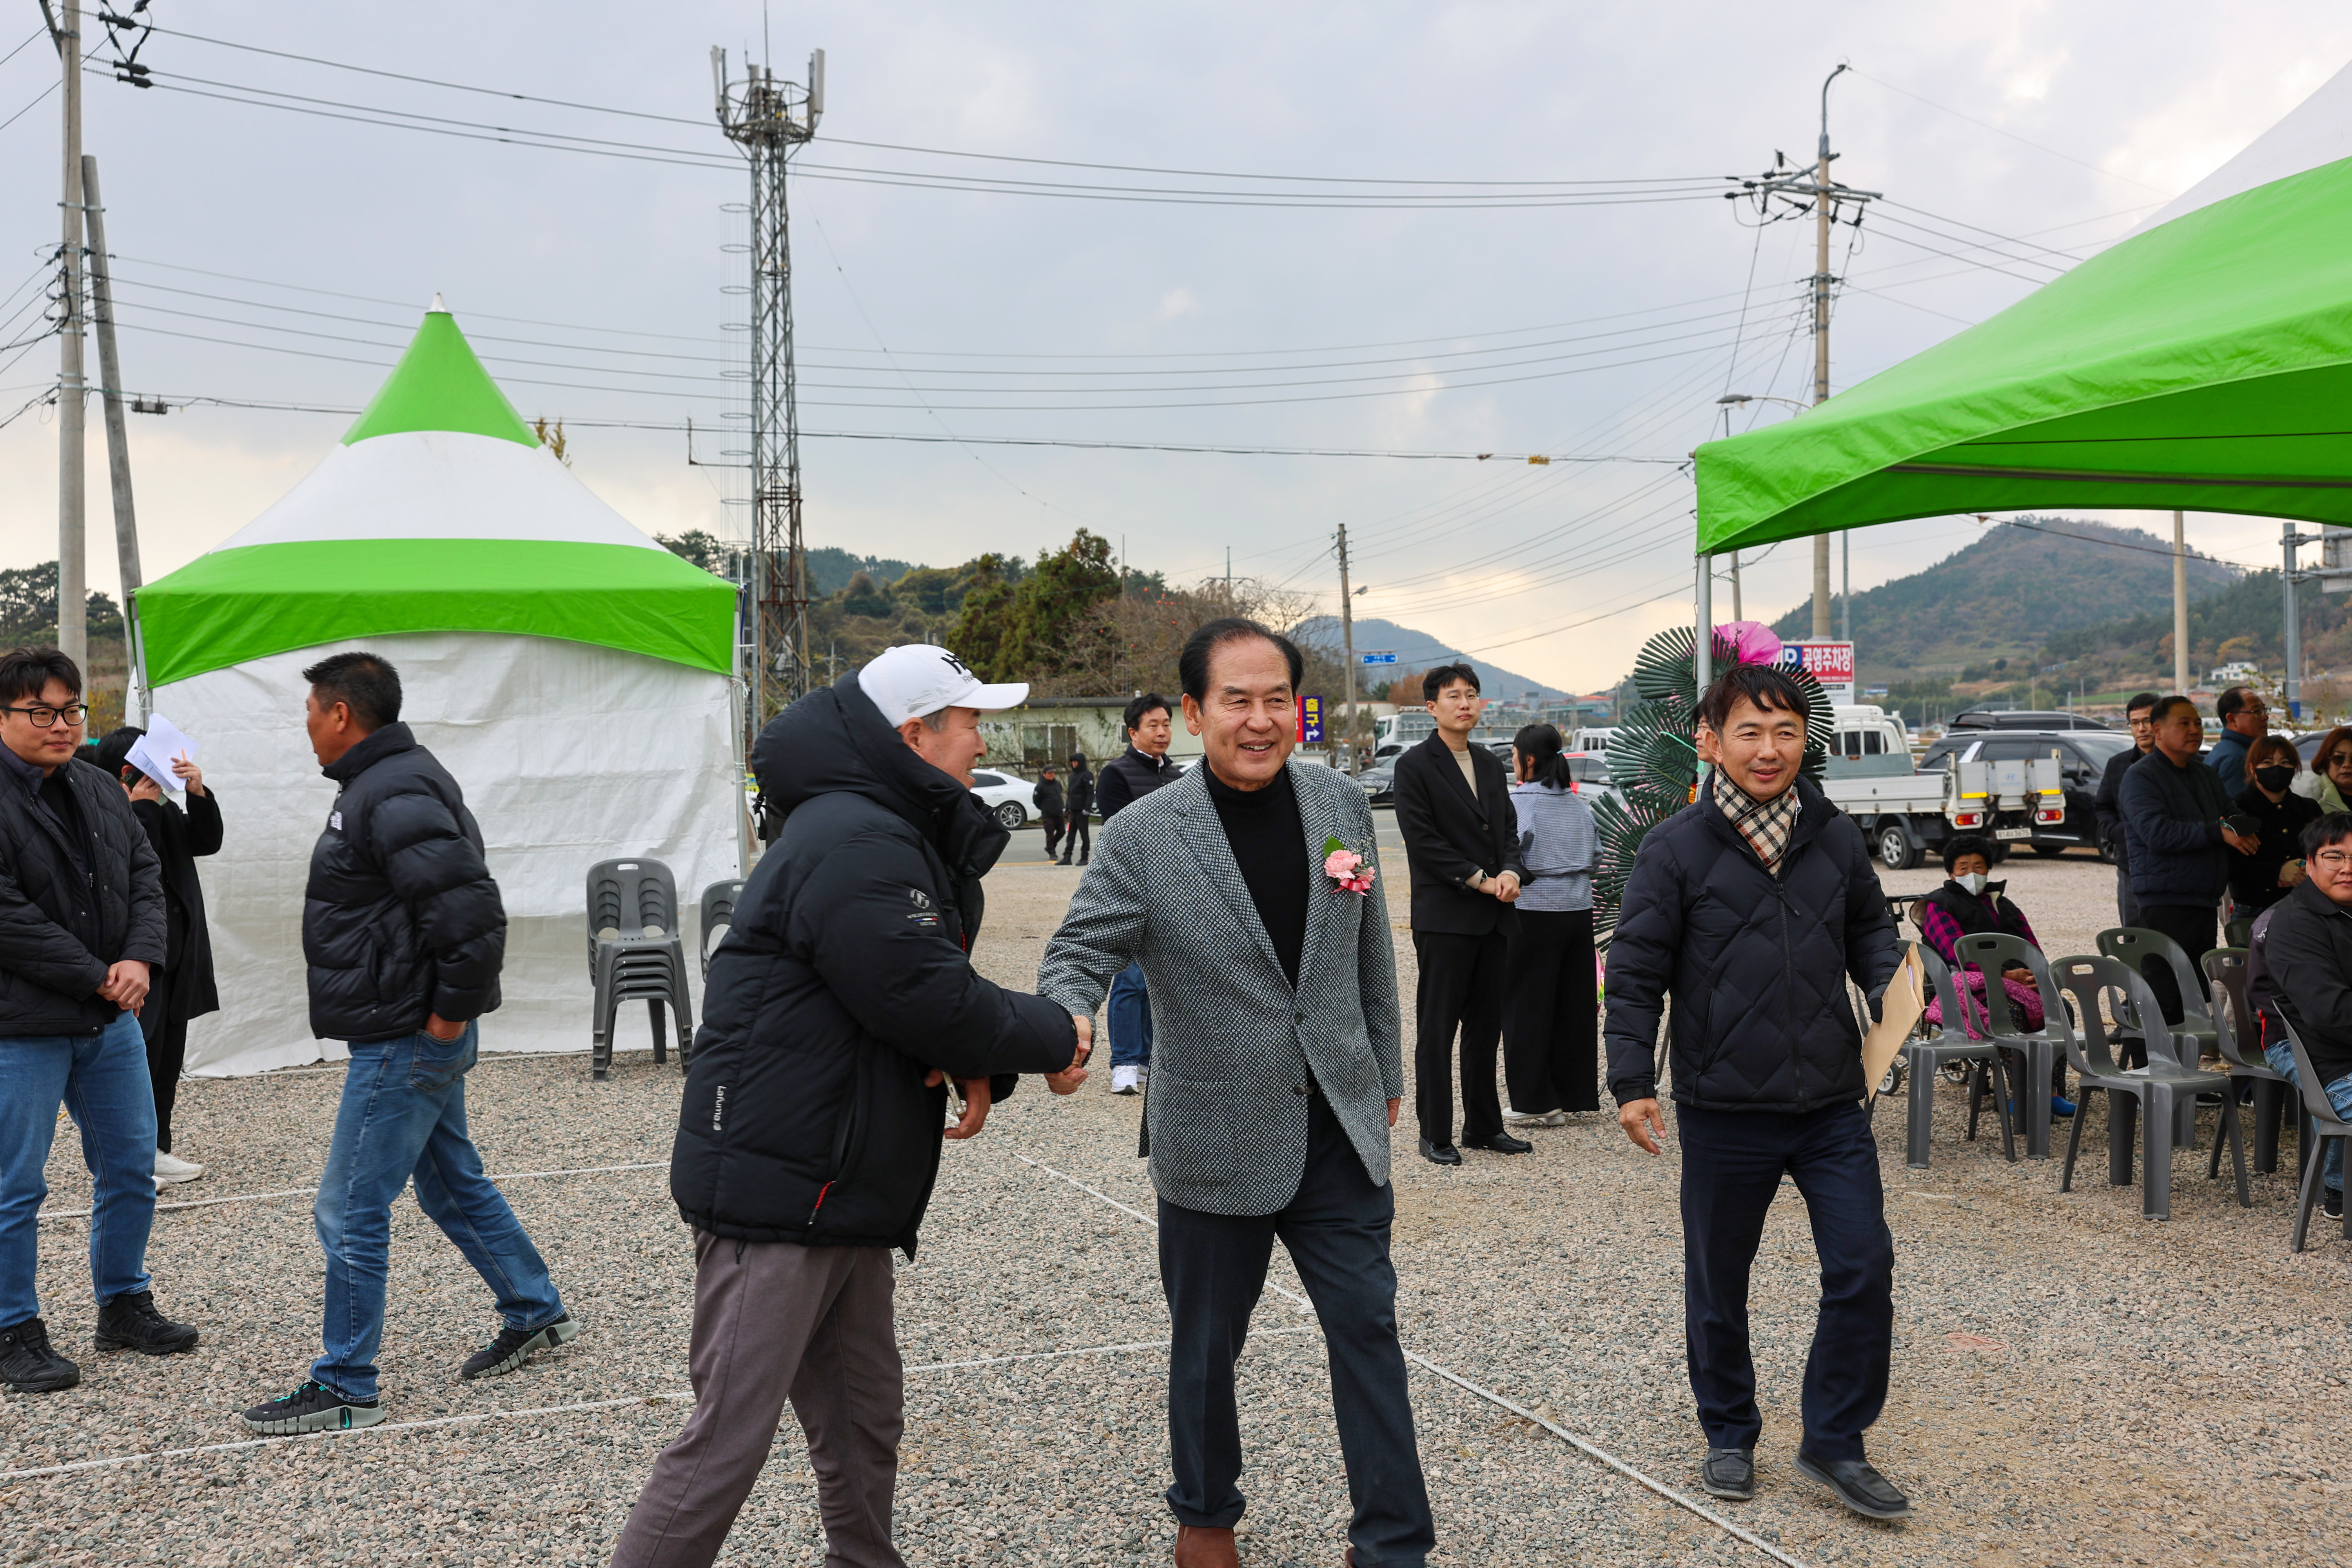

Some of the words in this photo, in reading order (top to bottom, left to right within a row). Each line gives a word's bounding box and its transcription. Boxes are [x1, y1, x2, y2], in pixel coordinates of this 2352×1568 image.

[1784, 648, 1798, 671] P
[1803, 647, 1851, 672] 공영주차장
[1305, 698, 1319, 727] 출구
[713, 1085, 726, 1121] Lafuma
